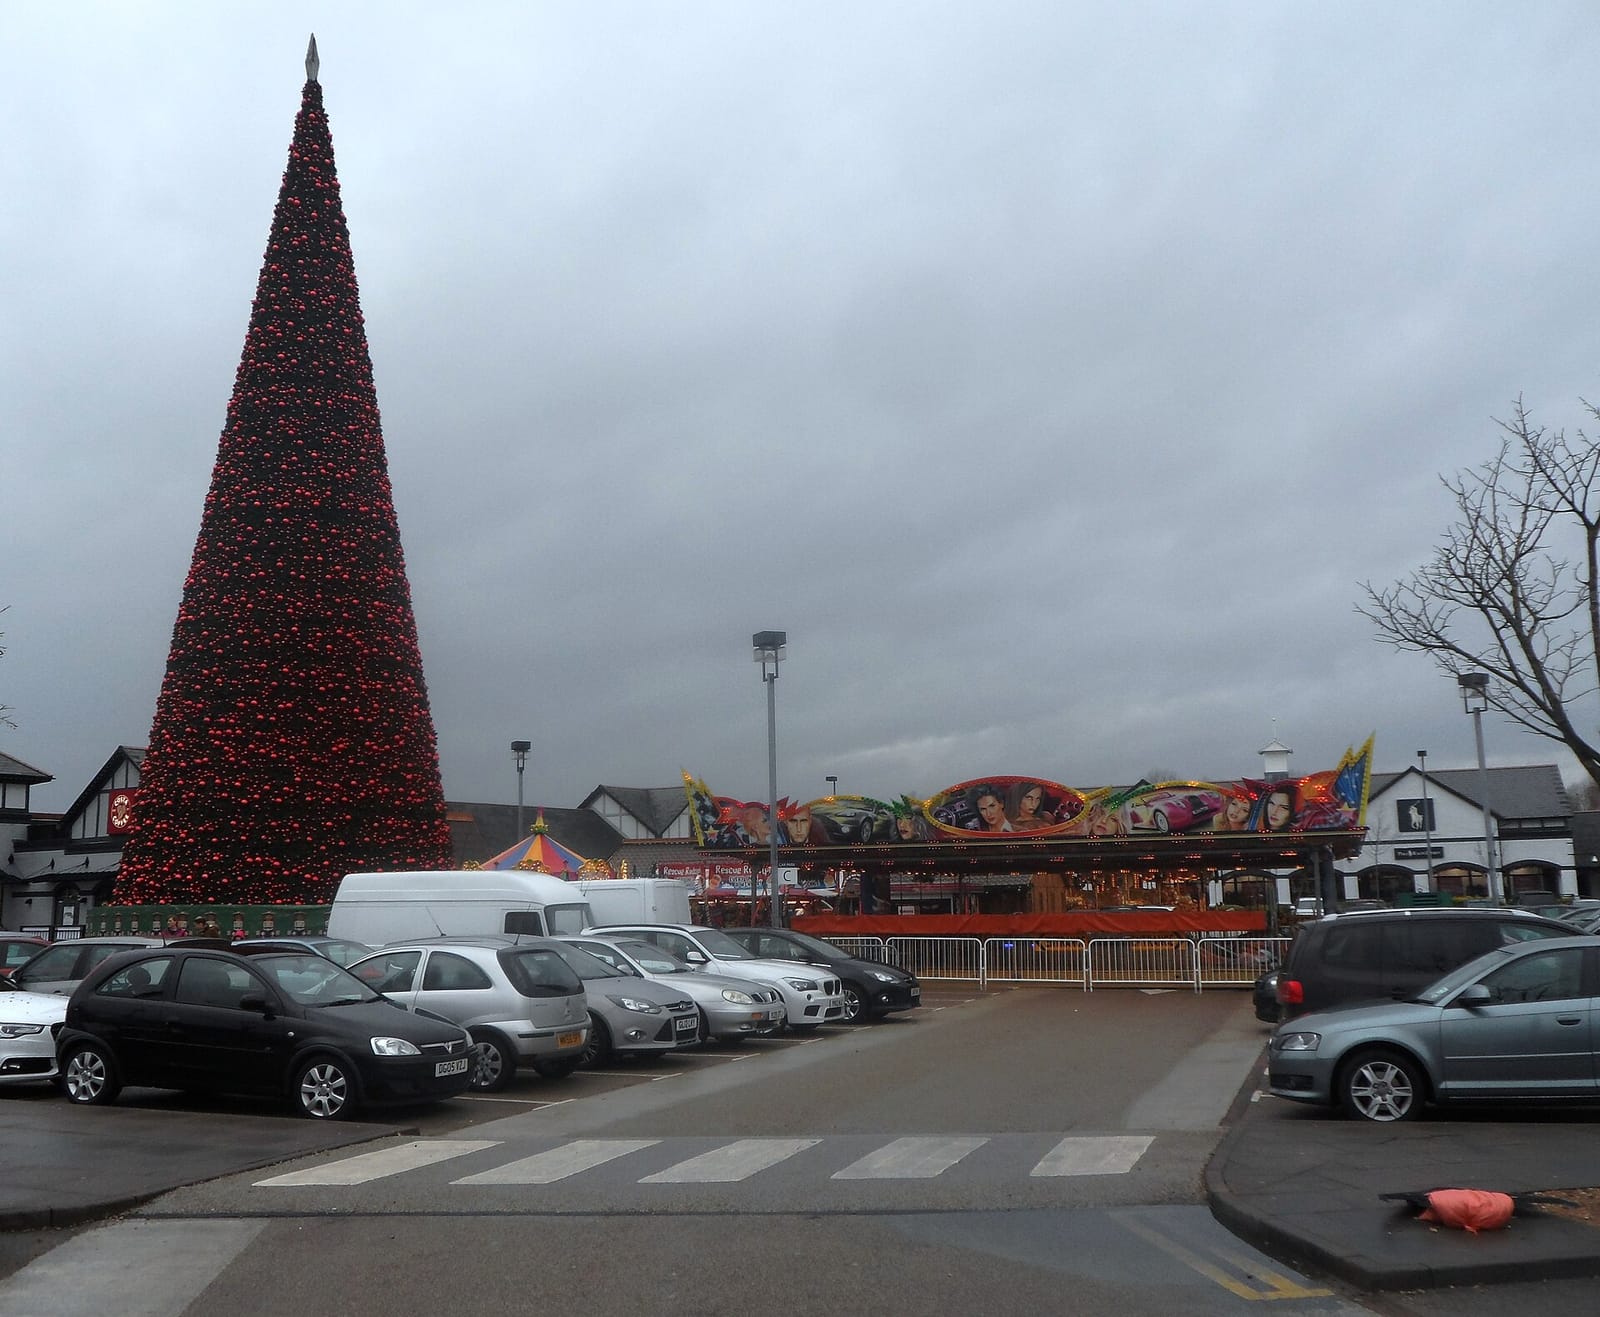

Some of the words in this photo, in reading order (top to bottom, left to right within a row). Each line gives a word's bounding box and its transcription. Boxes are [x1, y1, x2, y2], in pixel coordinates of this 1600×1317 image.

[114, 796, 128, 806] COSTA
[112, 815, 130, 826] COFFEE
[716, 865, 742, 875] Rescue
[783, 870, 792, 882] C
